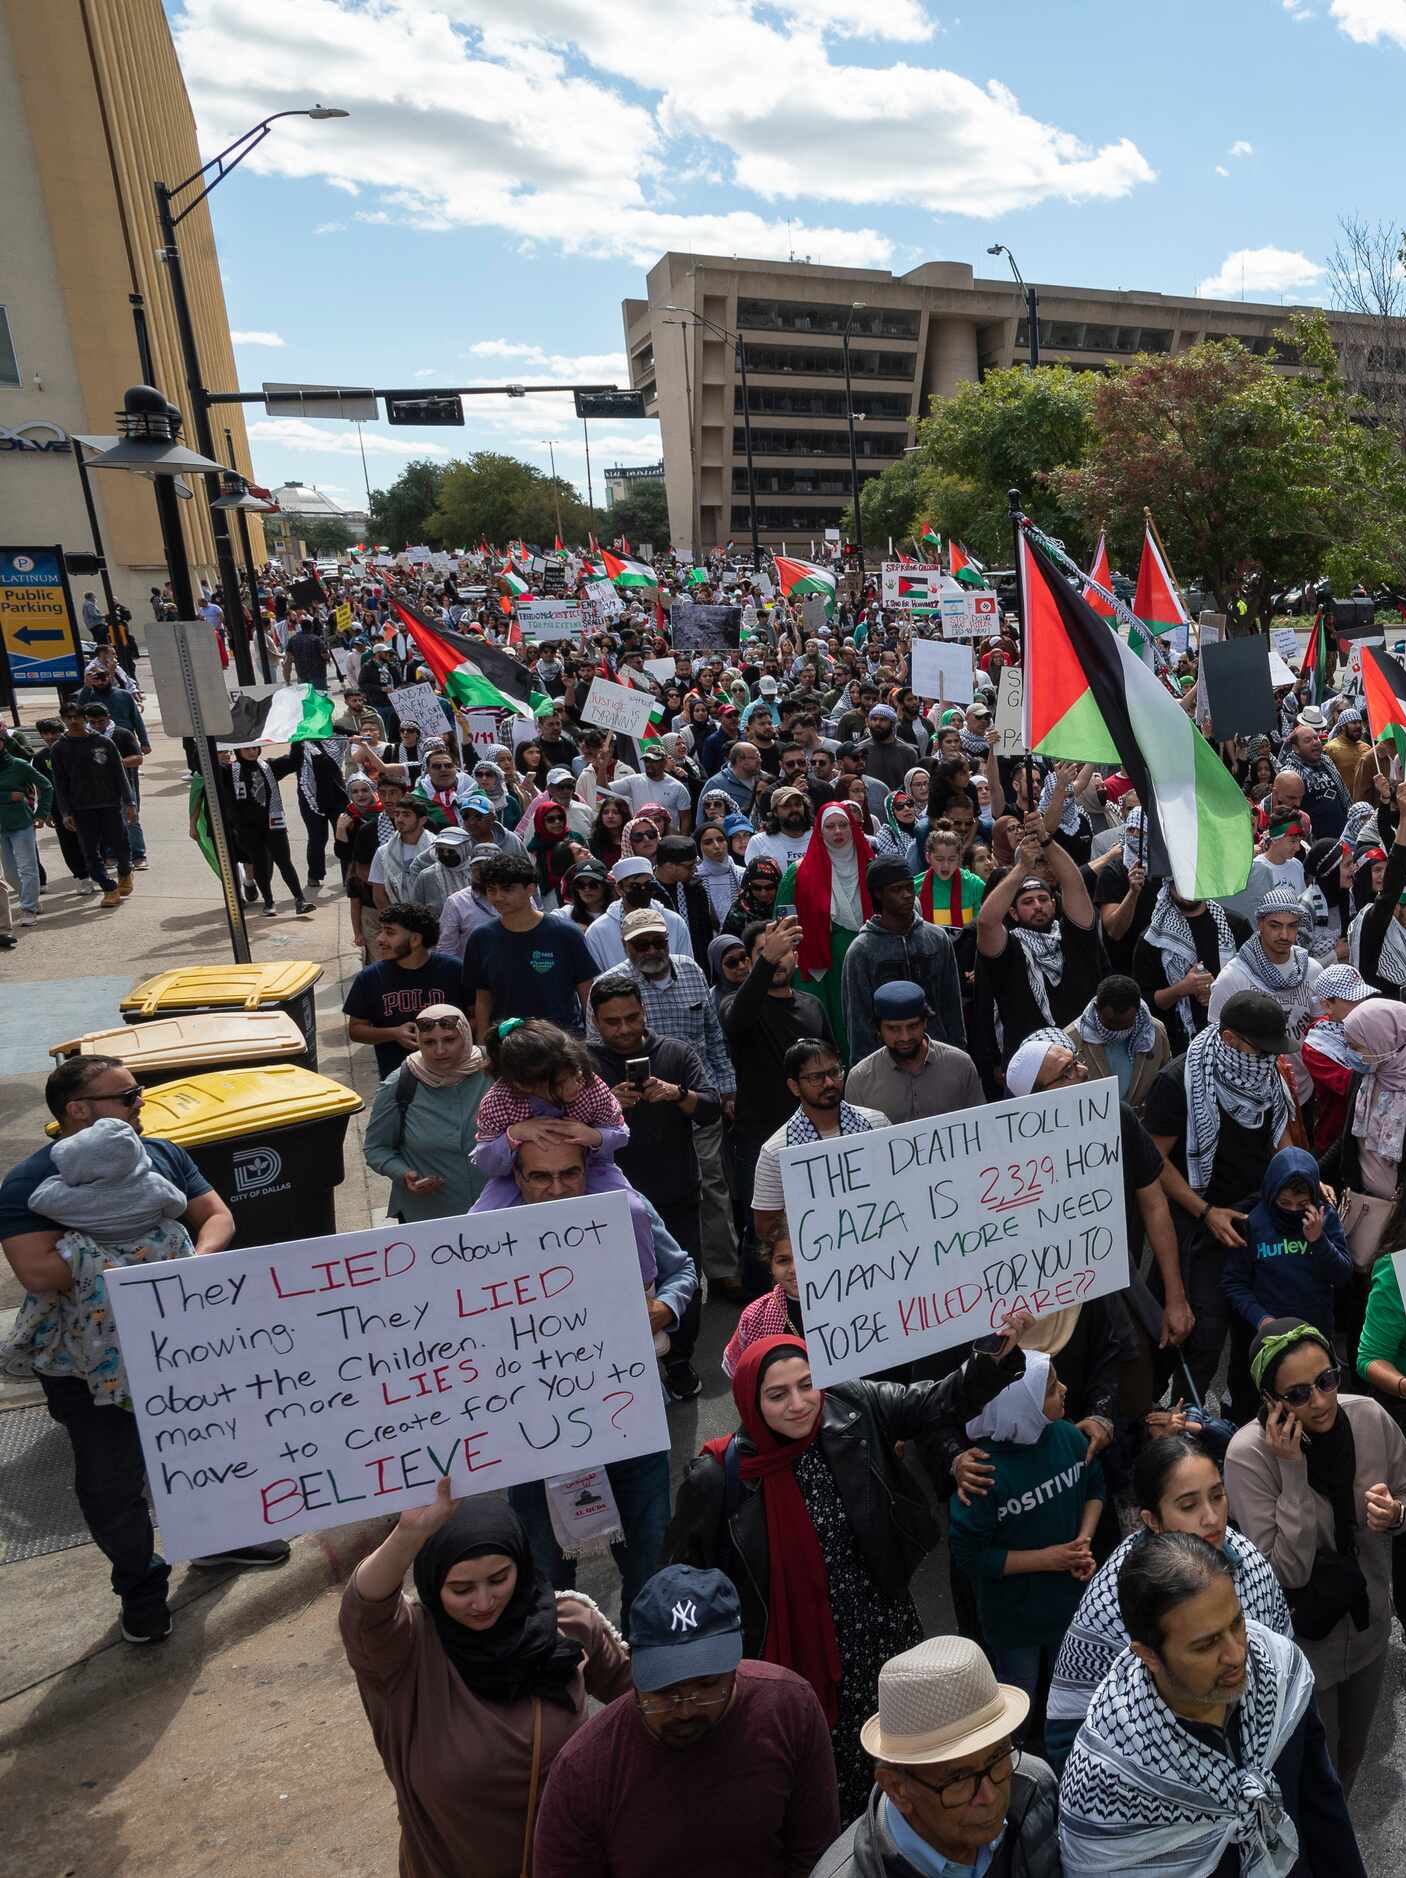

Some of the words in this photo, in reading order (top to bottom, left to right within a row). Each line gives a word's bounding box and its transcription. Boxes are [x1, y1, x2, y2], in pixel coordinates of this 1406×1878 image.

[0, 602, 63, 615] Parking
[4, 589, 54, 601] Public
[791, 1148, 870, 1199] THE
[888, 1121, 981, 1176] DEATH
[995, 1109, 1069, 1143] TOLL
[1079, 1091, 1109, 1127] IN
[230, 1194, 248, 1202] CITY
[249, 1190, 260, 1198] OF
[262, 1182, 291, 1194] DALLAS
[799, 1200, 908, 1262] GAZA
[929, 1180, 958, 1220] IS
[1066, 1136, 1119, 1178] HOW
[120, 1273, 247, 1319] They
[271, 1242, 416, 1300] LIED
[431, 1231, 519, 1265] about
[539, 1219, 608, 1252] not
[805, 1246, 919, 1311] MANY
[934, 1216, 1019, 1266] MORE
[1038, 1189, 1113, 1228] NEED
[898, 1283, 983, 1336] KILLED
[984, 1253, 1027, 1302] FOR
[1033, 1239, 1072, 1289] YOU
[1080, 1226, 1114, 1266] TO
[317, 1302, 430, 1341] They
[457, 1265, 574, 1318] LIED
[990, 1270, 1096, 1329] CARE??
[145, 1382, 237, 1417] about
[246, 1367, 316, 1399] the
[155, 1418, 237, 1453] many
[265, 1390, 359, 1428] more
[382, 1359, 480, 1406] LIES
[495, 1355, 522, 1378] do
[533, 1341, 605, 1370] they
[162, 1461, 259, 1494] have
[280, 1441, 319, 1463] to
[461, 1385, 527, 1421] for
[607, 1360, 646, 1383] to
[261, 1431, 503, 1526] BELIEVE
[998, 1460, 1088, 1522] POSITIVIT
[671, 1599, 698, 1632] NY
